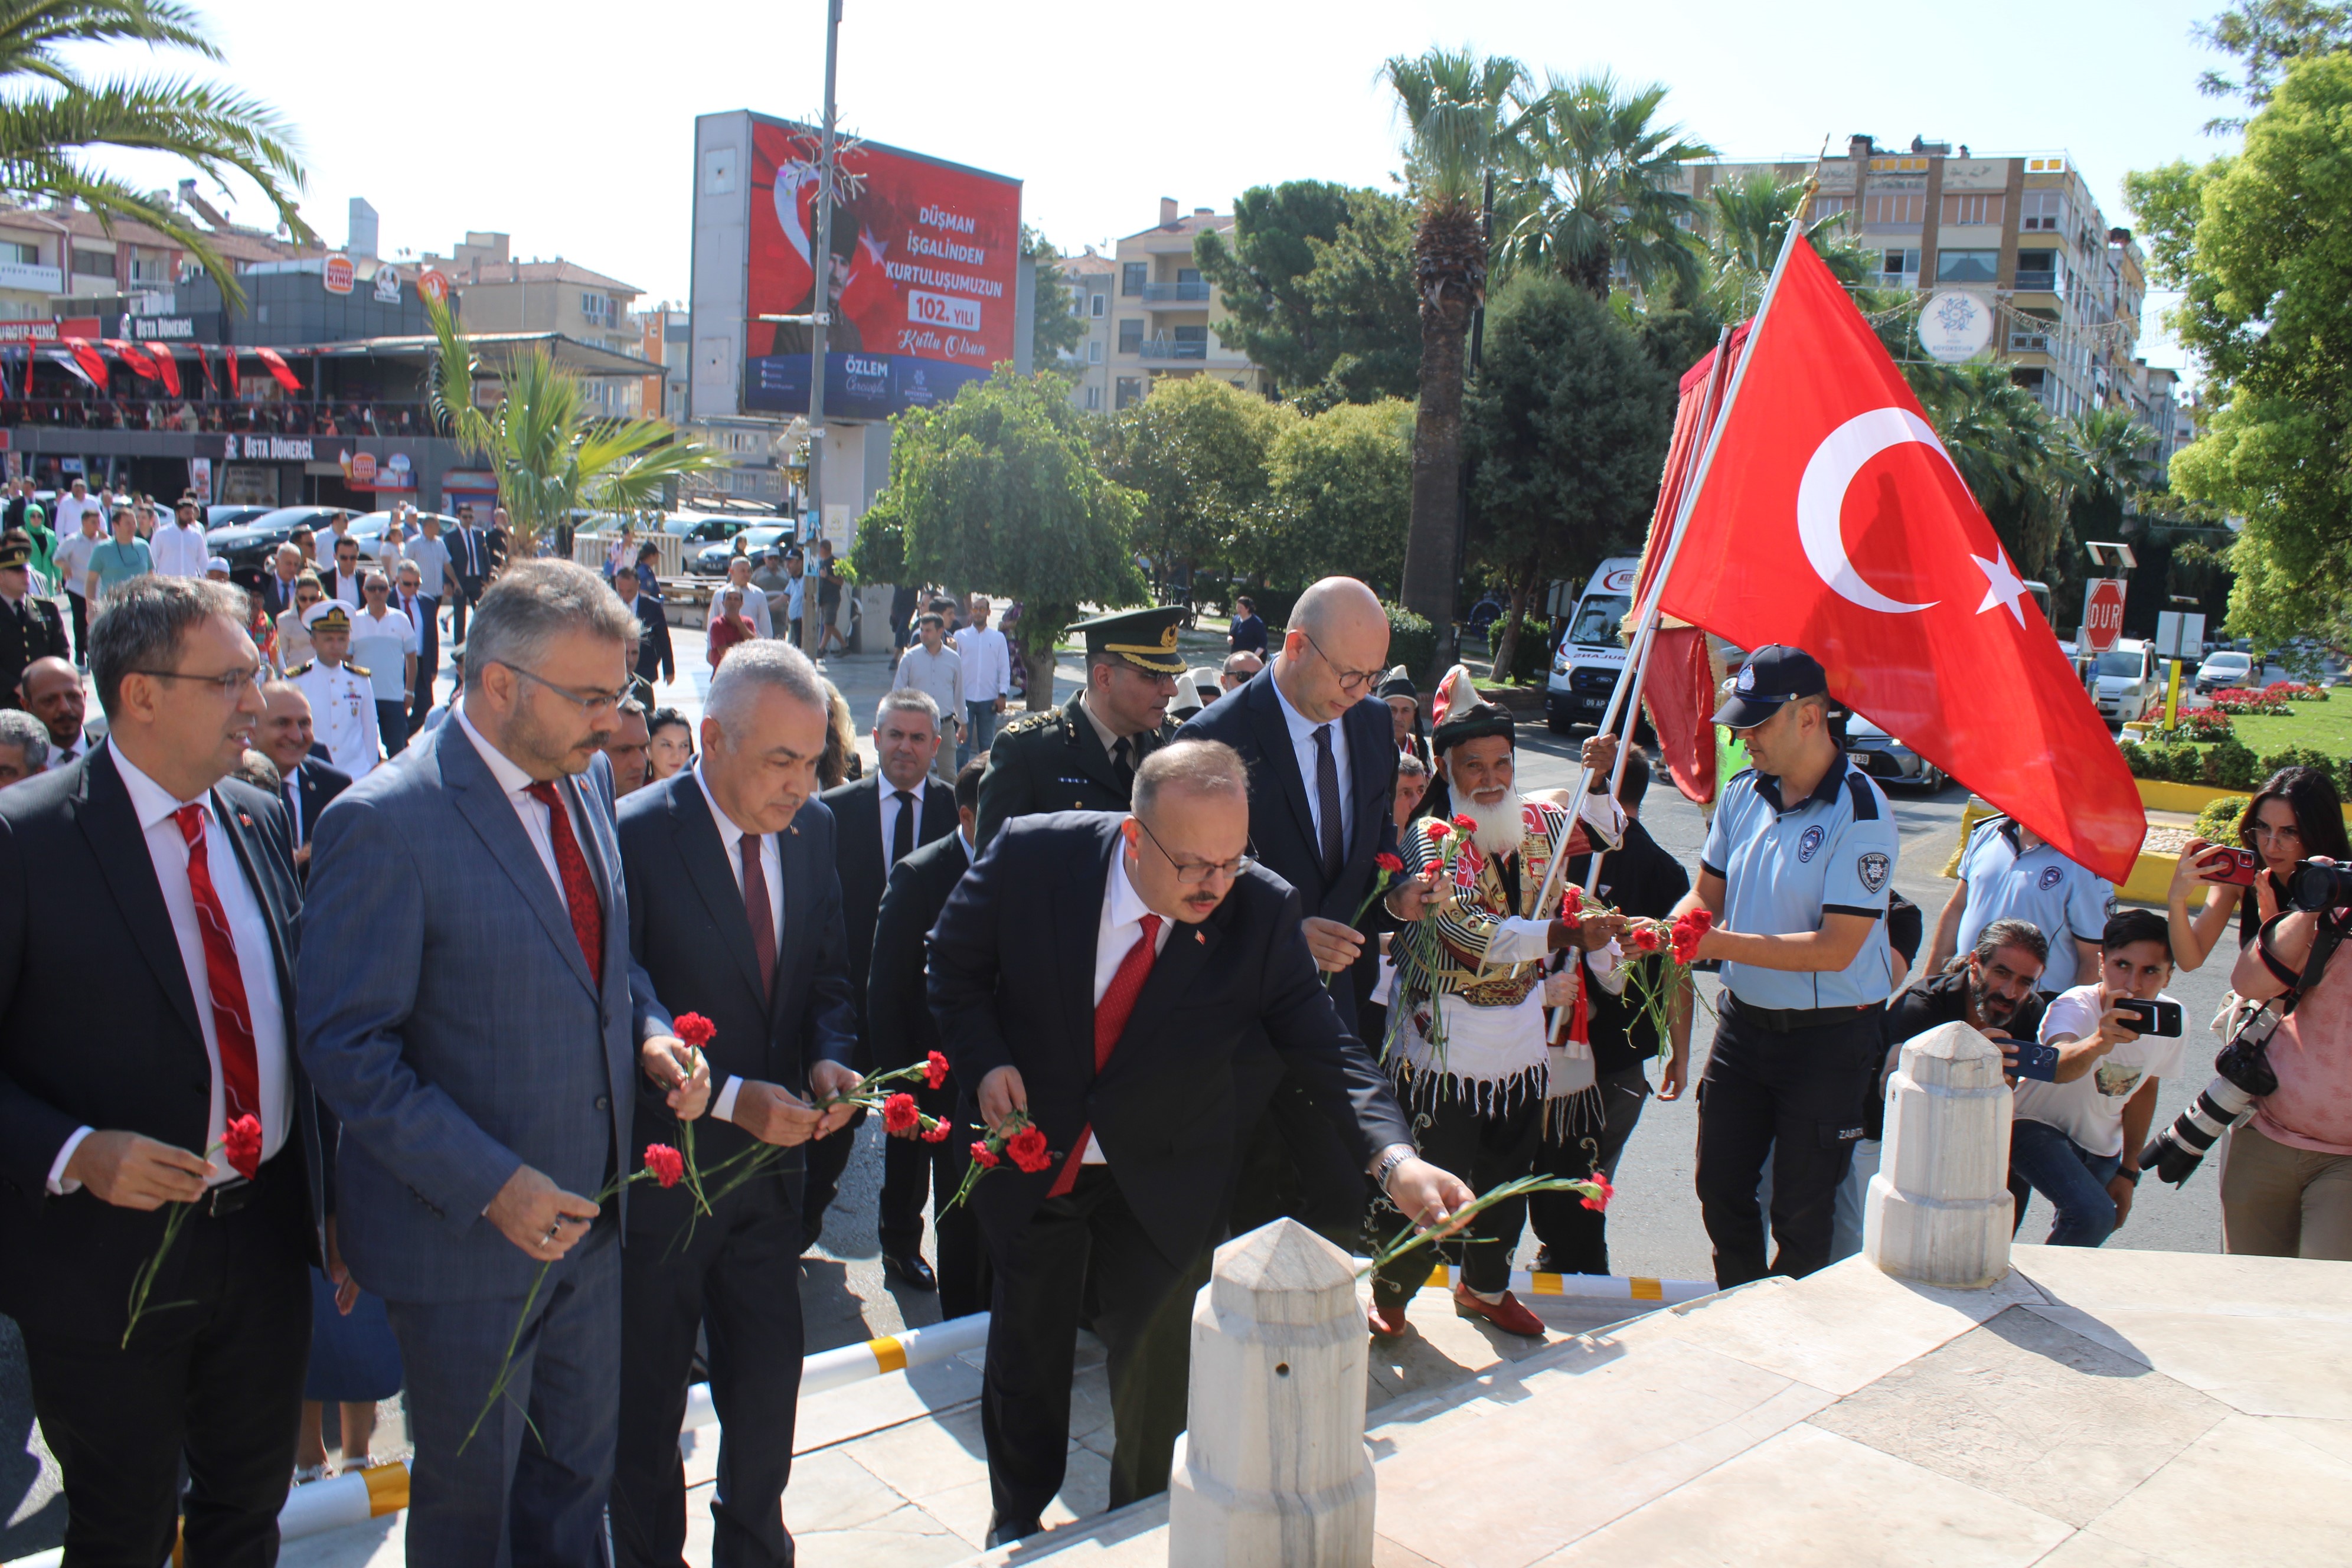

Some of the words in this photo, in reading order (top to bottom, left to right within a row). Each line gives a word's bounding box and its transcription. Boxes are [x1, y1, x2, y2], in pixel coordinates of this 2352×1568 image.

[919, 204, 975, 234] DÜŞMAN
[907, 230, 984, 265] İŞGALİNDEN
[328, 274, 353, 286] KING
[886, 262, 1002, 298] KURTULUŞUMUZUN
[916, 296, 949, 322] 102.
[954, 309, 974, 326] YILI
[0, 324, 30, 341] URGER
[32, 324, 57, 341] KING
[136, 318, 157, 339] USTA
[158, 317, 194, 338] DÖNERCİ
[898, 329, 941, 356] Kutlu
[945, 335, 986, 357] Olsun
[845, 354, 887, 378] ÖZLEM
[244, 436, 269, 459] USTA
[270, 436, 313, 460] DÖNERCİ
[2090, 603, 2120, 629] DUR
[1839, 1128, 1864, 1139] ZABITA
